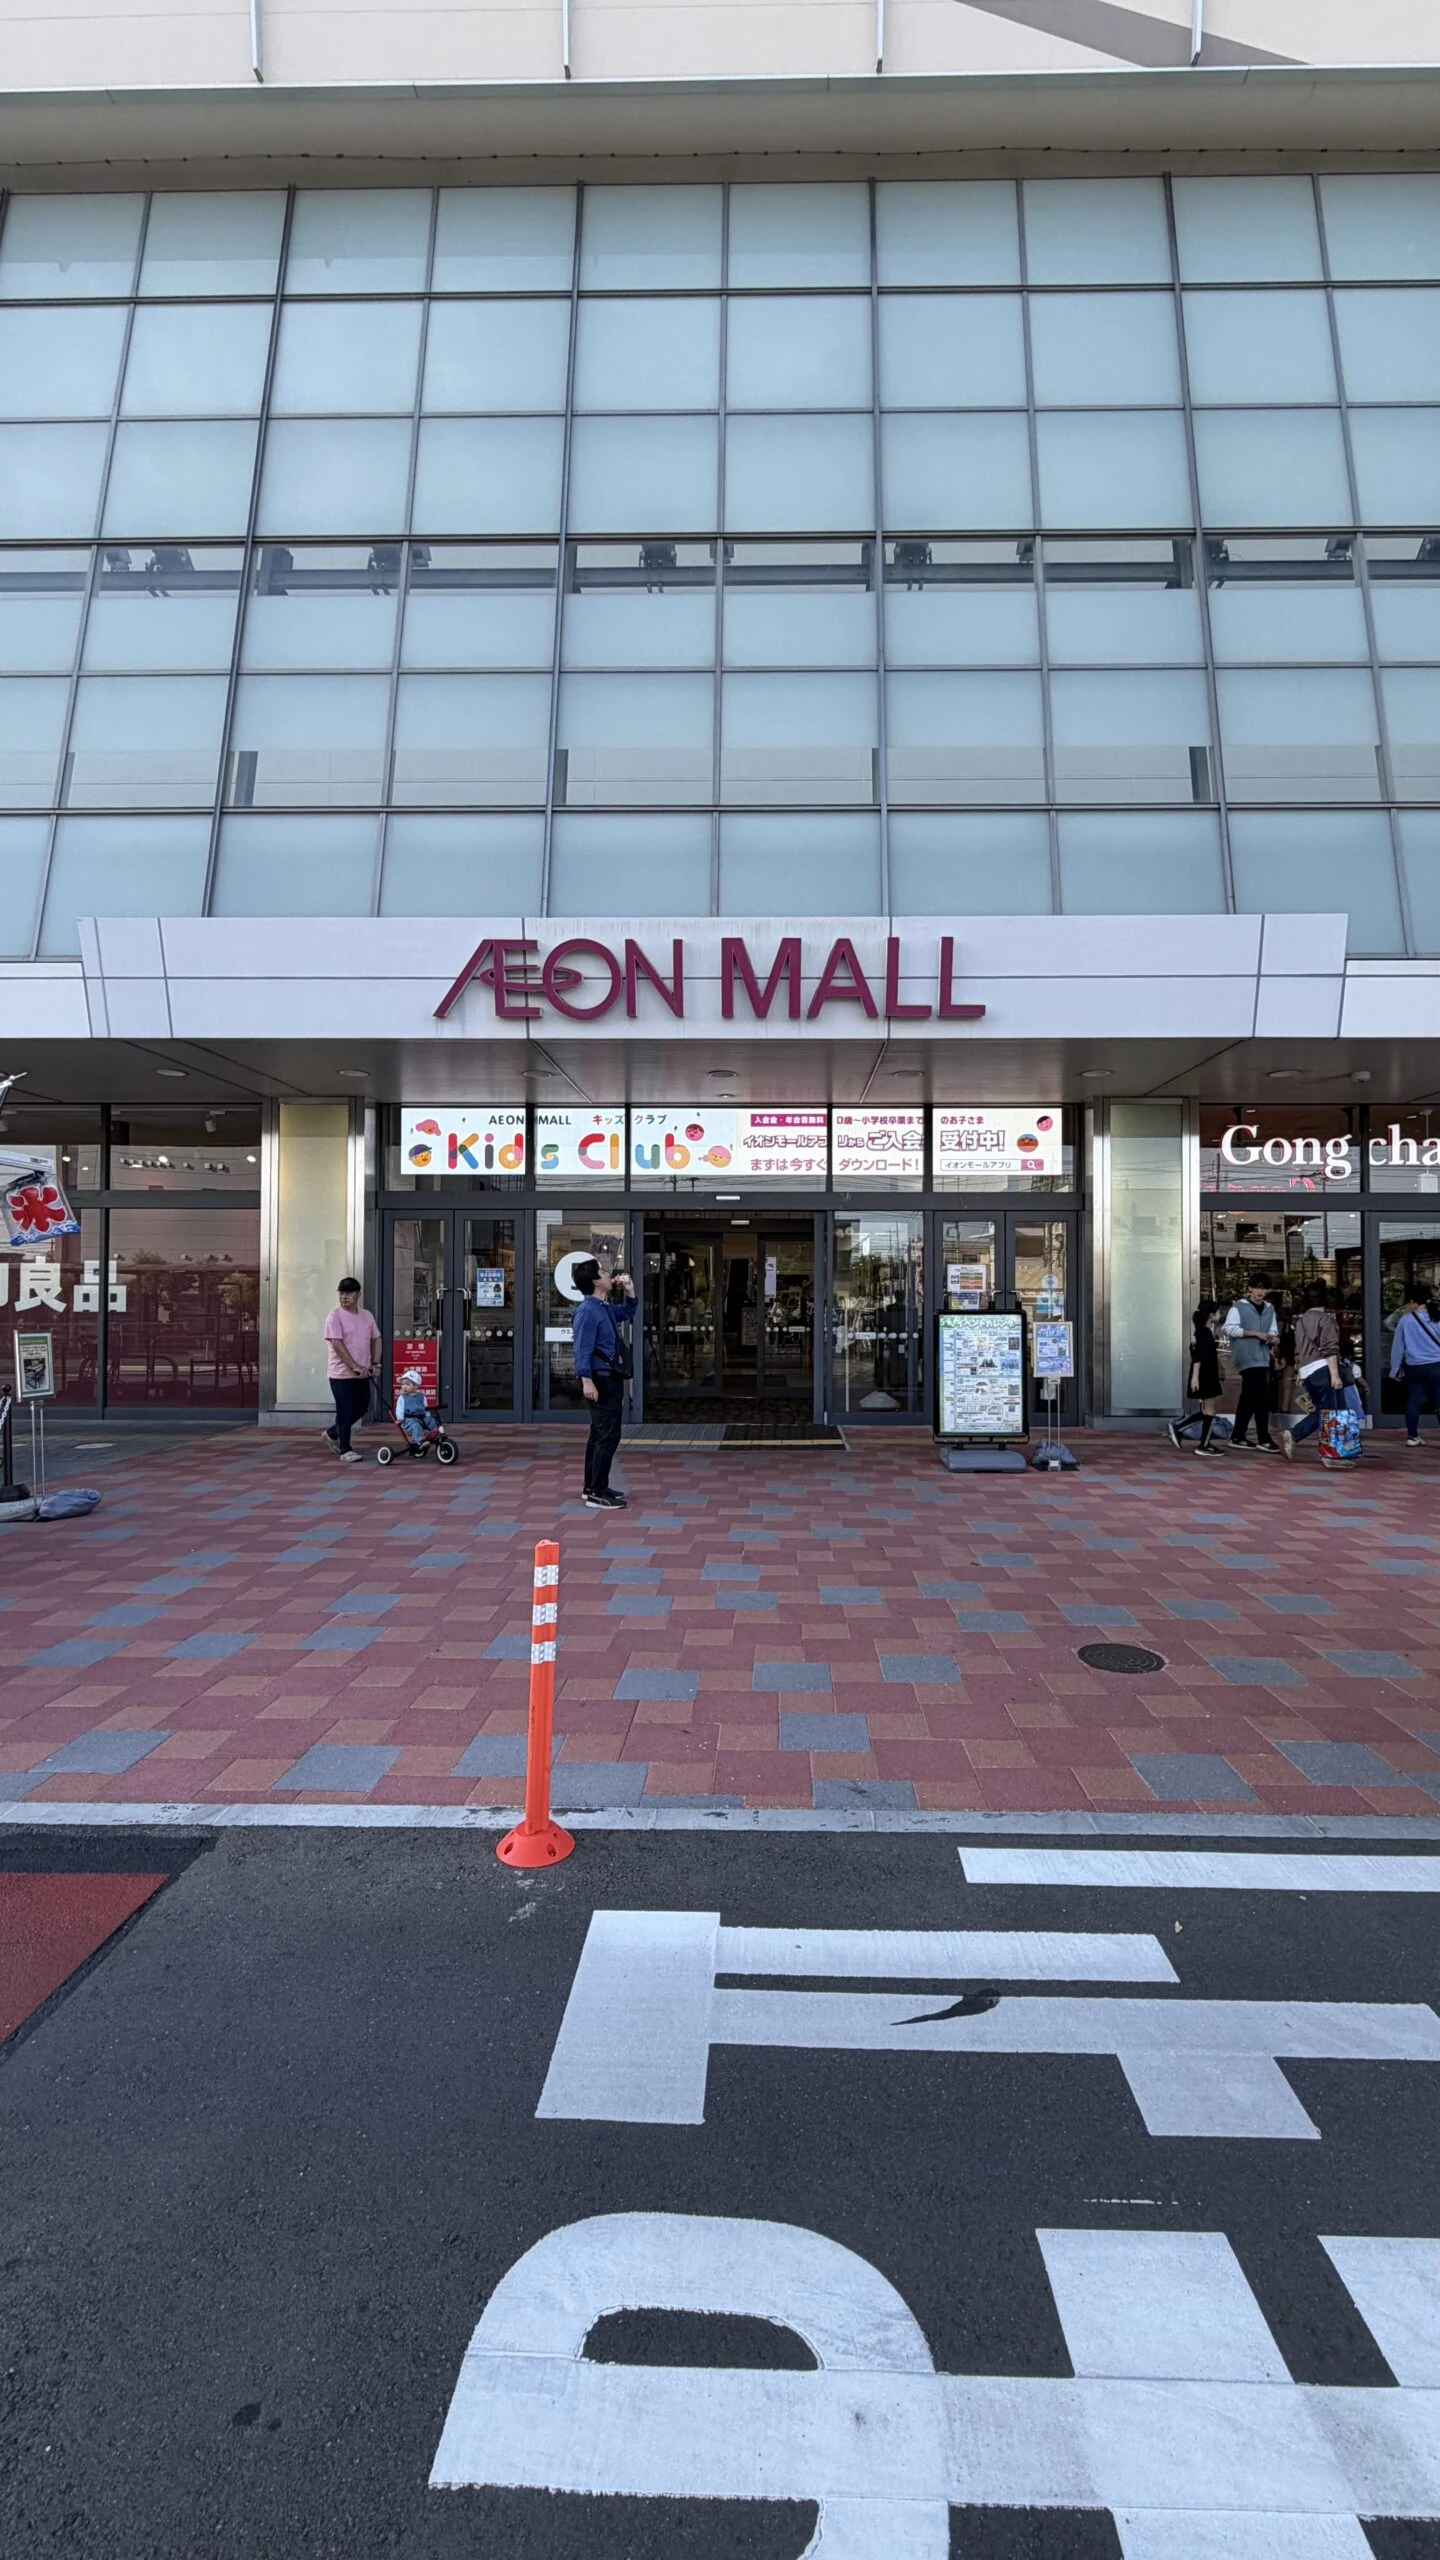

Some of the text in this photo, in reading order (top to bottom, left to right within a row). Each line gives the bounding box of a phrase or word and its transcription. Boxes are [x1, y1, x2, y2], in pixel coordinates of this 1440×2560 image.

[720, 937, 986, 1018] MALL
[488, 1115, 571, 1125] AEON MALL
[448, 1133, 691, 1170] Kids Club
[1221, 1124, 1440, 1179] Gong cha
[0, 1255, 127, 1313] 良品
